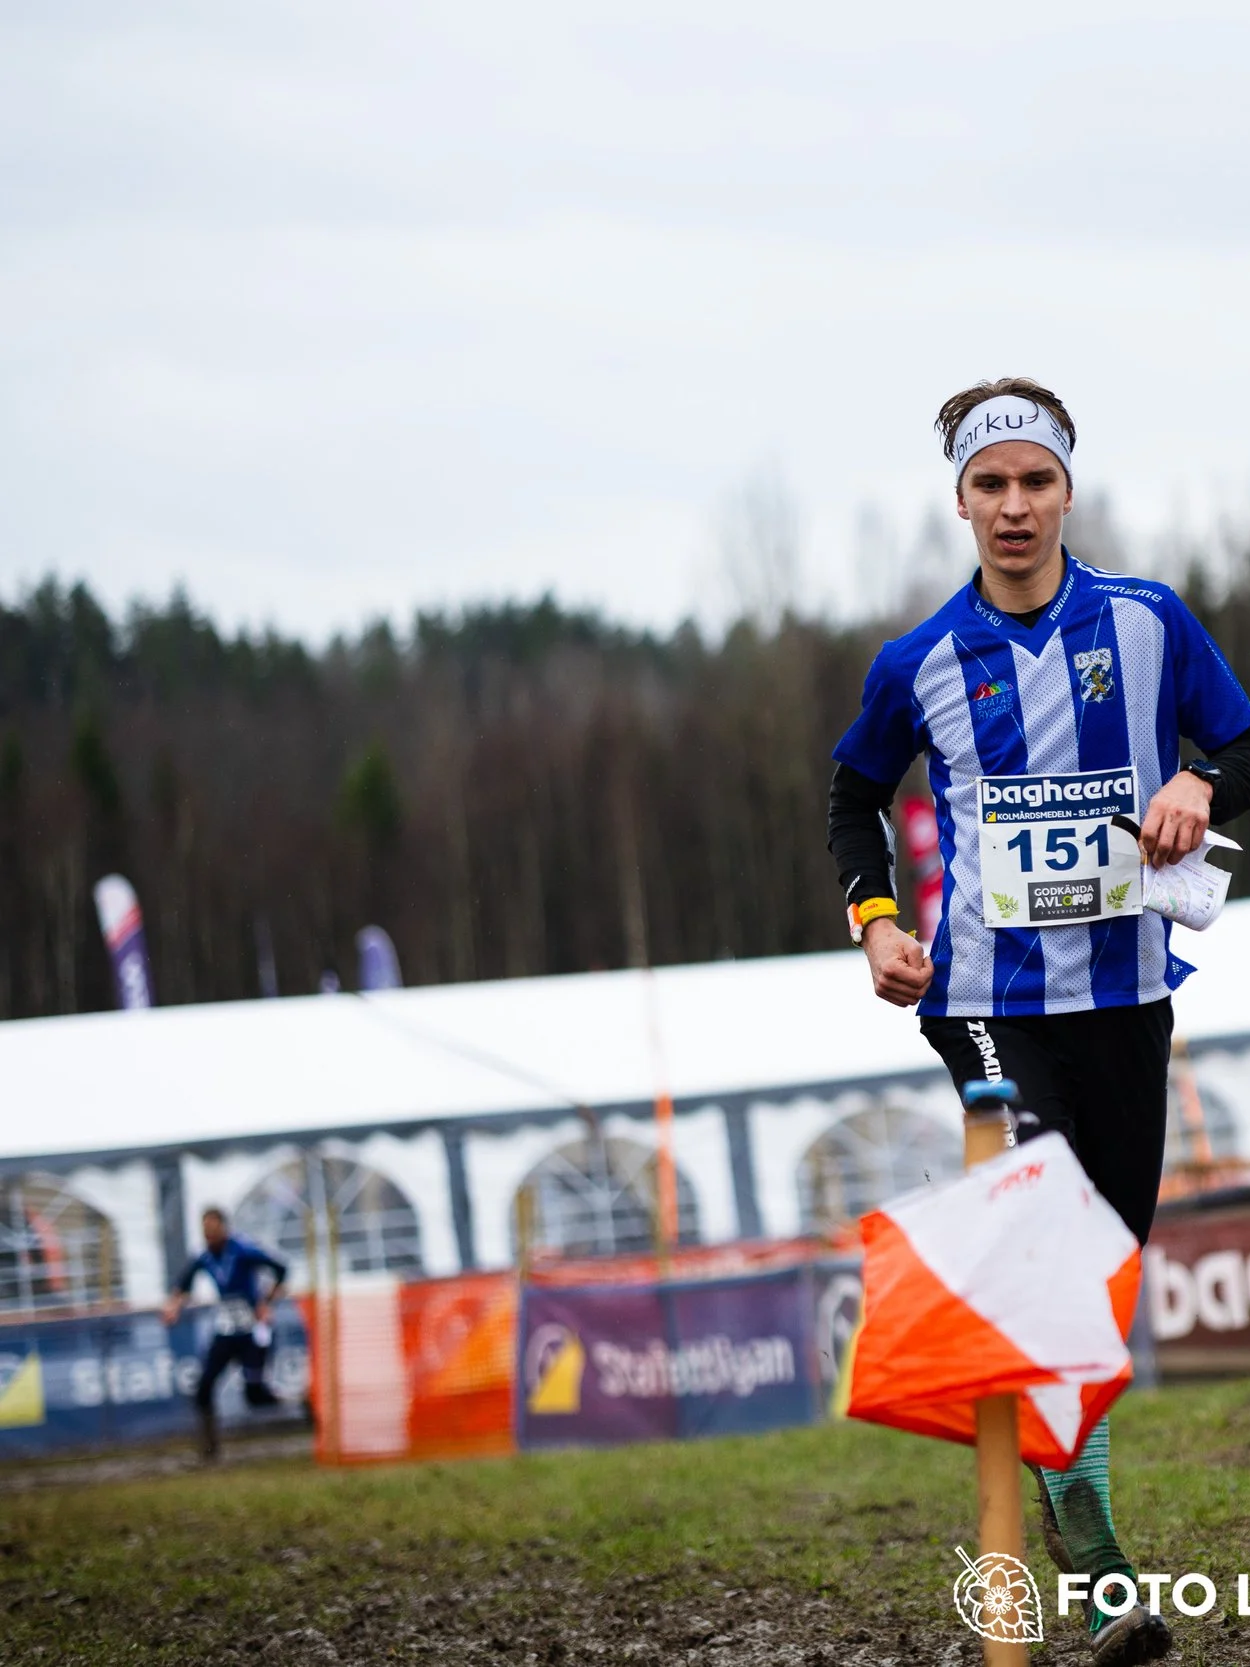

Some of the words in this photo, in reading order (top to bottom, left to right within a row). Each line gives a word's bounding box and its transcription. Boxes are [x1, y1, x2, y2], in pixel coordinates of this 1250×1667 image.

[1049, 573, 1075, 622] noname
[1091, 584, 1163, 603] noname
[983, 777, 1132, 807] bagheera
[997, 810, 1072, 821] KOLMÅRDSMEDELN
[1089, 807, 1100, 816] #2
[1102, 806, 1120, 815] 2026
[1007, 824, 1110, 872] 151
[1034, 884, 1094, 896] GODKÄNDA
